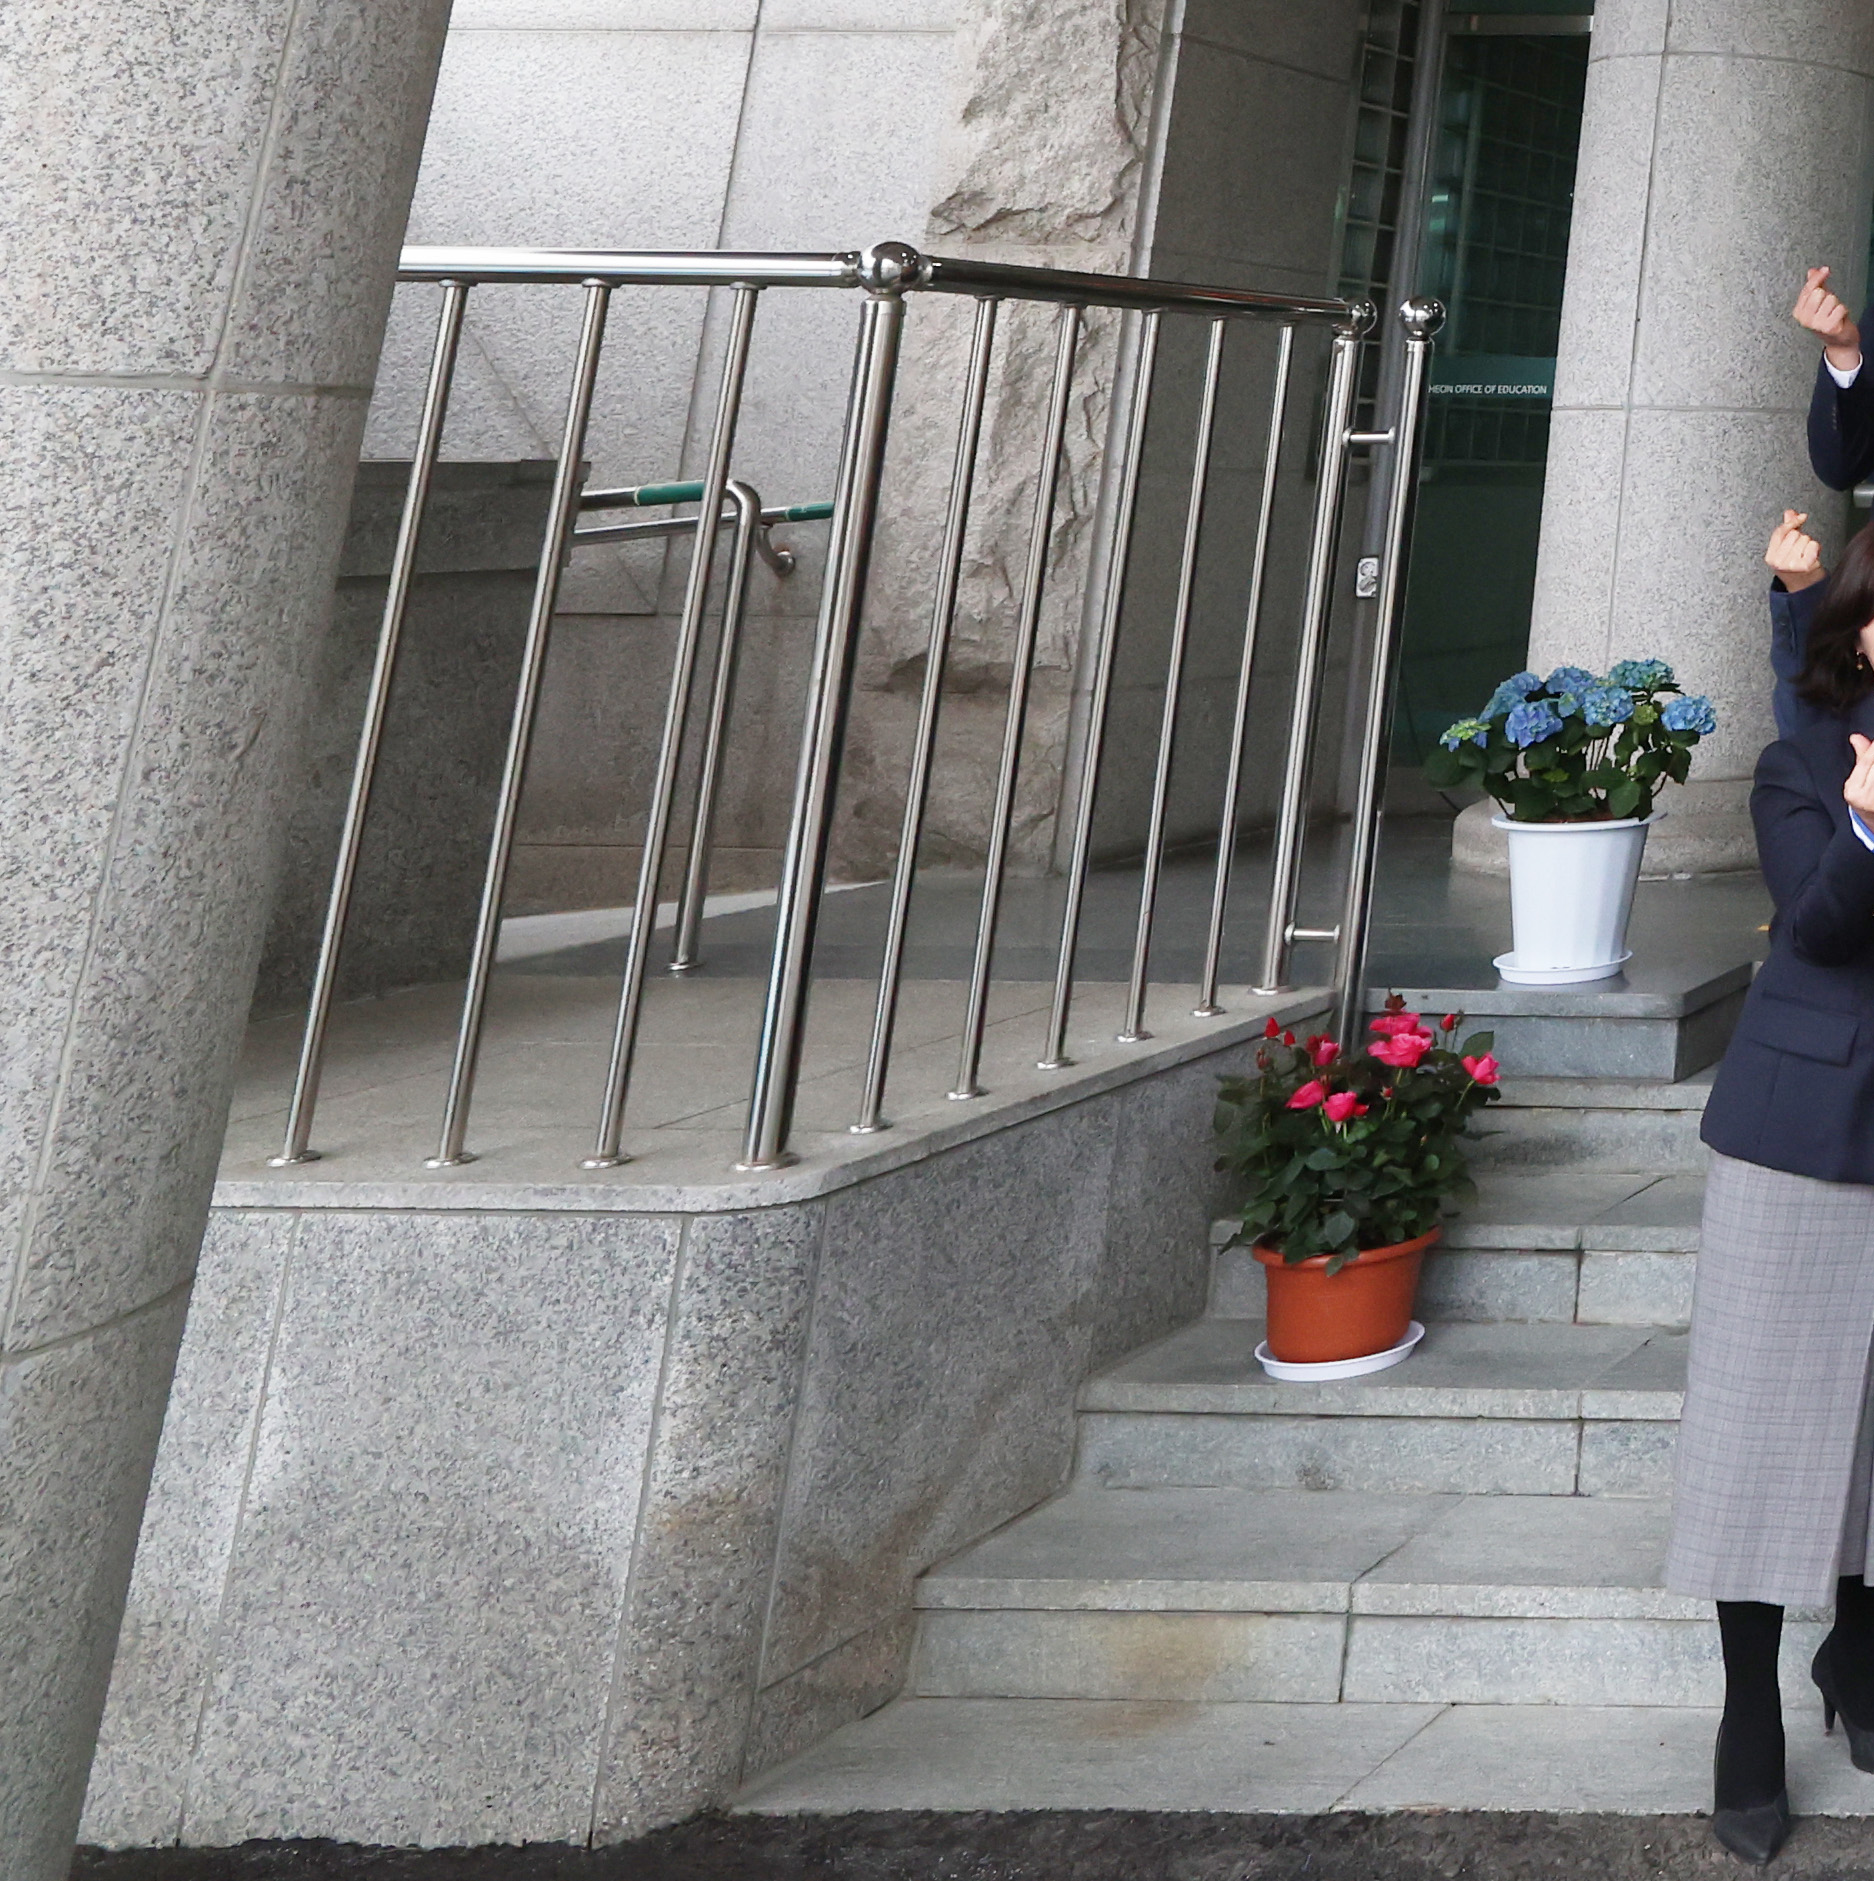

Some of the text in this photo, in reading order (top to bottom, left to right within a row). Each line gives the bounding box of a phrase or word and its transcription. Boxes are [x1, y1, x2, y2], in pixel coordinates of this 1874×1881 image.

[1455, 384, 1483, 393] OFFICE
[1484, 384, 1496, 394] OF
[1498, 385, 1547, 394] EDUCATION
